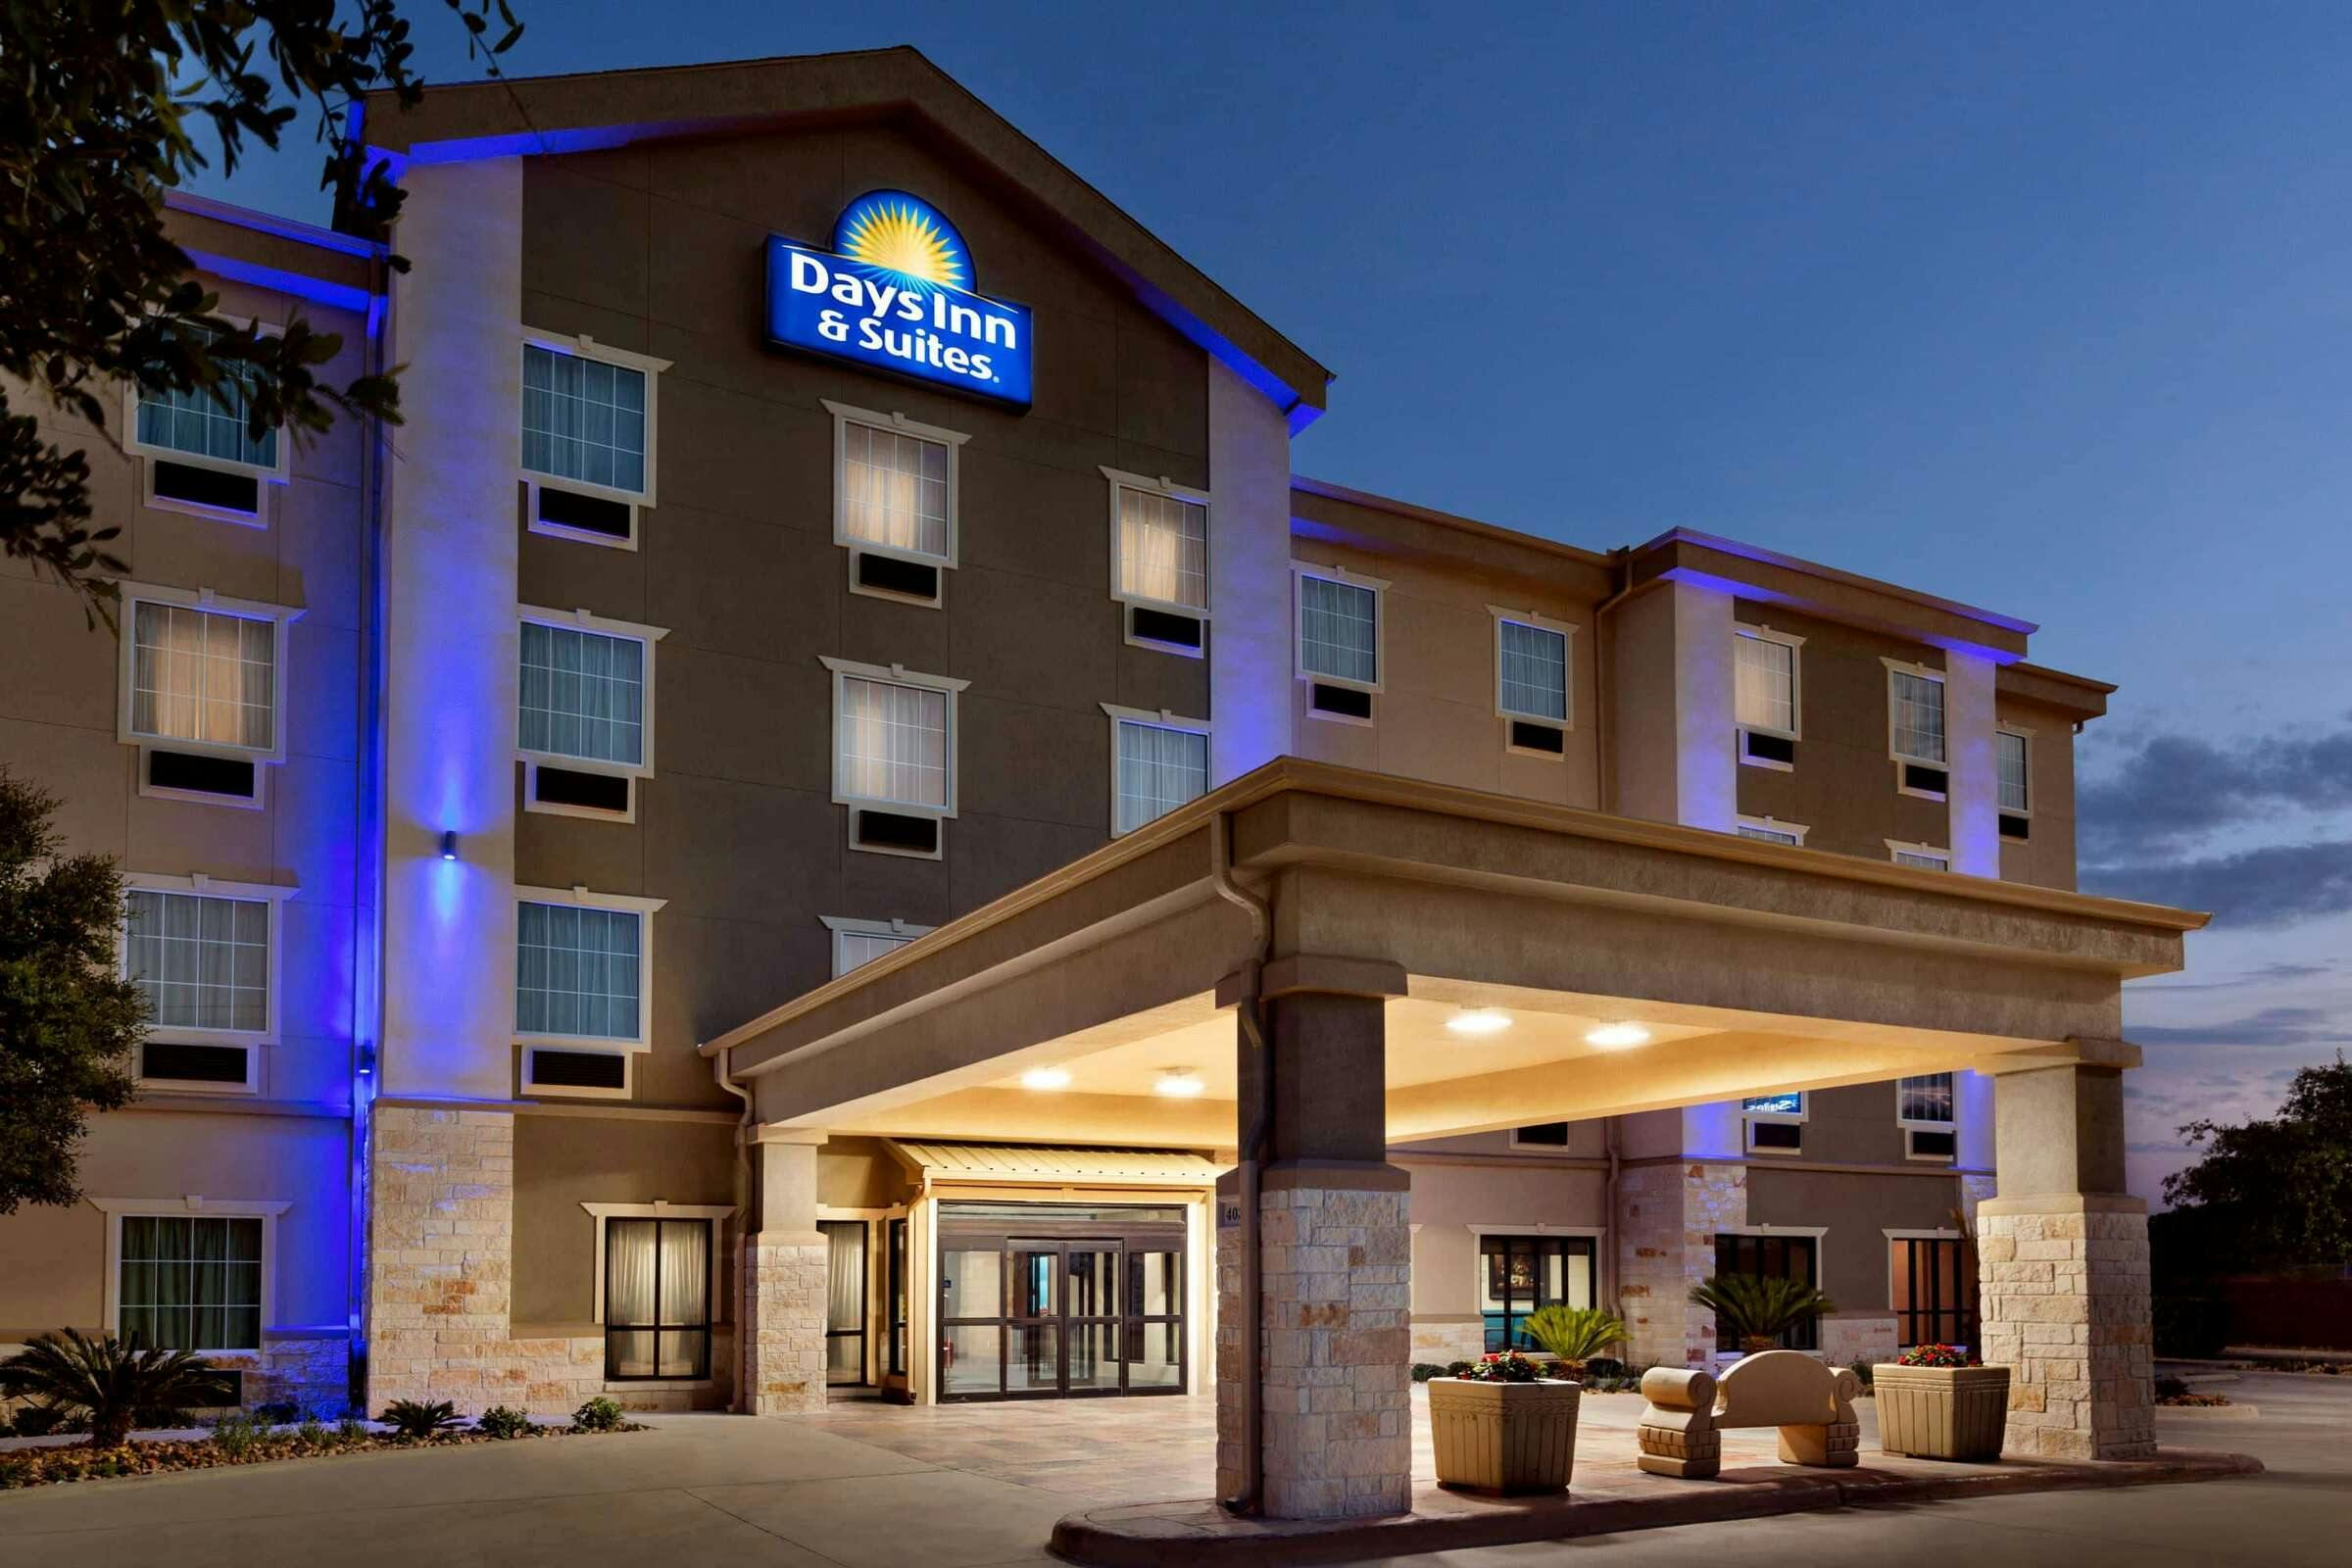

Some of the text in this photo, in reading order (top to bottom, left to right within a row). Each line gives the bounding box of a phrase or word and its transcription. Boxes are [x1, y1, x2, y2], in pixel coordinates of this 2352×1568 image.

[791, 251, 1016, 349] Days Inn
[817, 309, 850, 341] &
[1225, 1206, 1240, 1221] 40
